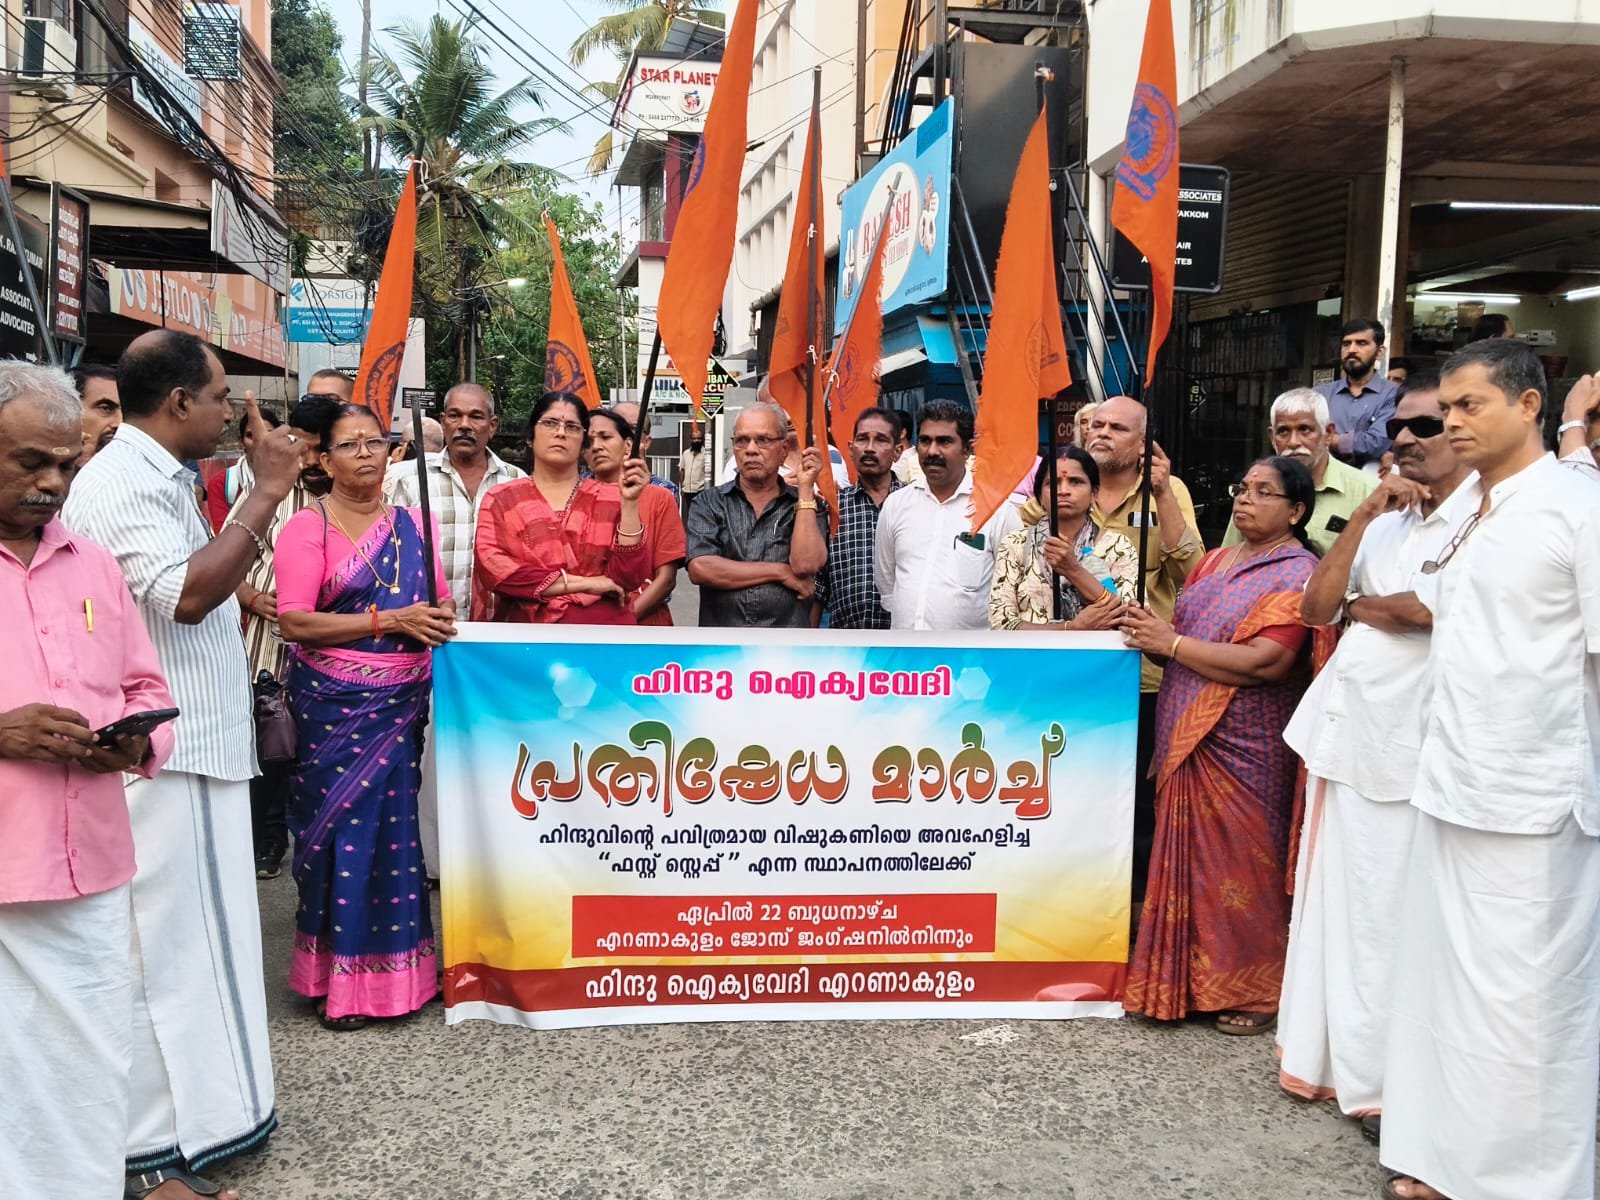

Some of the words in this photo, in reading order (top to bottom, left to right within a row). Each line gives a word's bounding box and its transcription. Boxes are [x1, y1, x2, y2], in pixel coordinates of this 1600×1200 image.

[641, 67, 670, 83] STAR
[674, 71, 718, 86] PLANET
[1177, 191, 1222, 201] SSOCIATES
[1176, 209, 1209, 219] AKKOM
[0, 311, 35, 336] ADVOCATES
[633, 663, 733, 700] ഹിന്ദു
[749, 665, 952, 701] ഐക്യവേദി
[511, 720, 849, 818] പ്രതിഷേധ
[872, 721, 1066, 819] മാർച്ച്
[661, 824, 767, 849] പവിത്രമായ
[774, 824, 911, 848] വിഷുകണിയെ
[918, 823, 1030, 848] അവഹേളിച്ച
[748, 855, 797, 877] എന്ന
[804, 851, 976, 873] സ്ഥാപനത്തിലേക്ക്
[677, 901, 753, 926] ഏപ്രിൽ
[760, 904, 781, 921] 22
[788, 900, 898, 925] ബുധനാഴ്ച
[596, 931, 724, 952] എറണാകുളം
[730, 926, 794, 948] ജോസ്
[798, 925, 974, 949] ജംഗ്ഷനിൽനിന്നും
[585, 968, 657, 1002] ഹിന്ദു
[667, 966, 810, 1001] ഐക്യവേദി
[818, 970, 976, 999] എറണാകുളം
